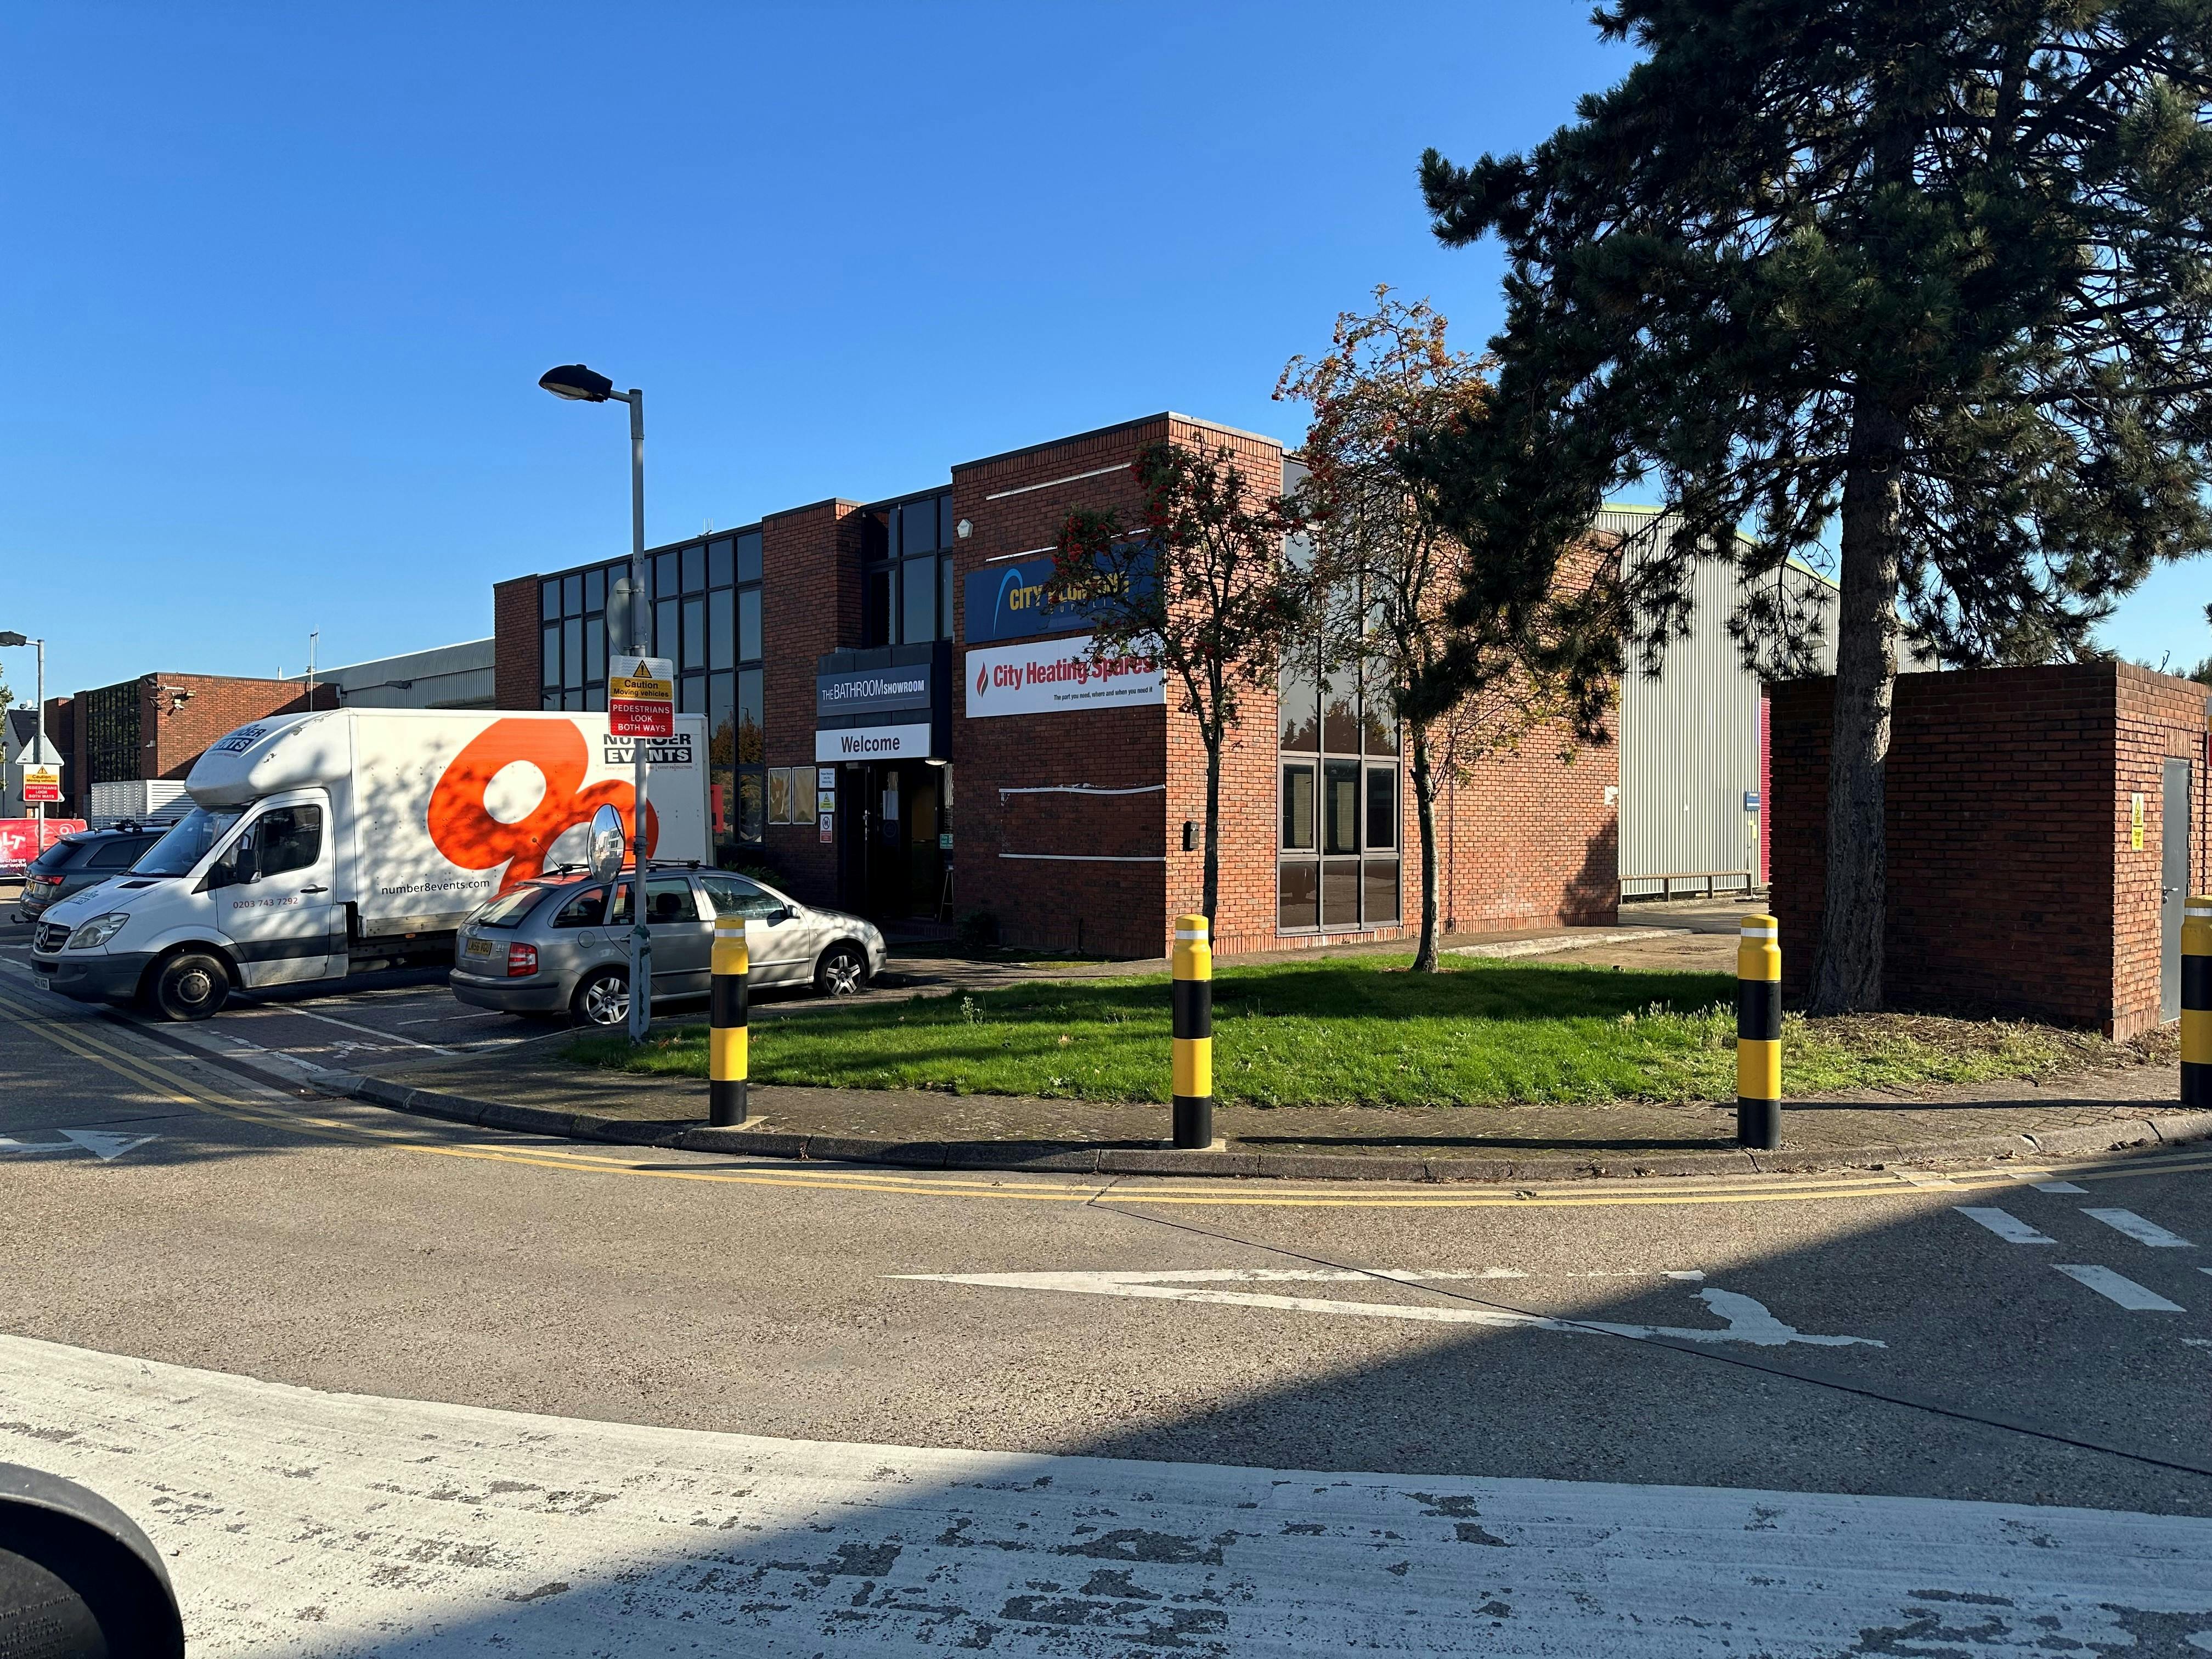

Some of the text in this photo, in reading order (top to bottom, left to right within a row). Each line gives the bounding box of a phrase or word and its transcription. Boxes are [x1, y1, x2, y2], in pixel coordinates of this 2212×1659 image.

[1009, 585, 1043, 610] CITY
[994, 664, 1023, 690] City
[1026, 658, 1087, 685] Heating
[624, 679, 658, 689] Caution
[613, 689, 639, 697] Moving
[613, 704, 670, 713] PEDESTRIANS
[618, 723, 666, 732] BOTH WAYS
[841, 735, 900, 753] Welcome
[607, 749, 690, 762] EVNTS
[381, 879, 490, 895] number8events.com
[233, 900, 255, 909] 0203
[276, 897, 298, 906] 7292
